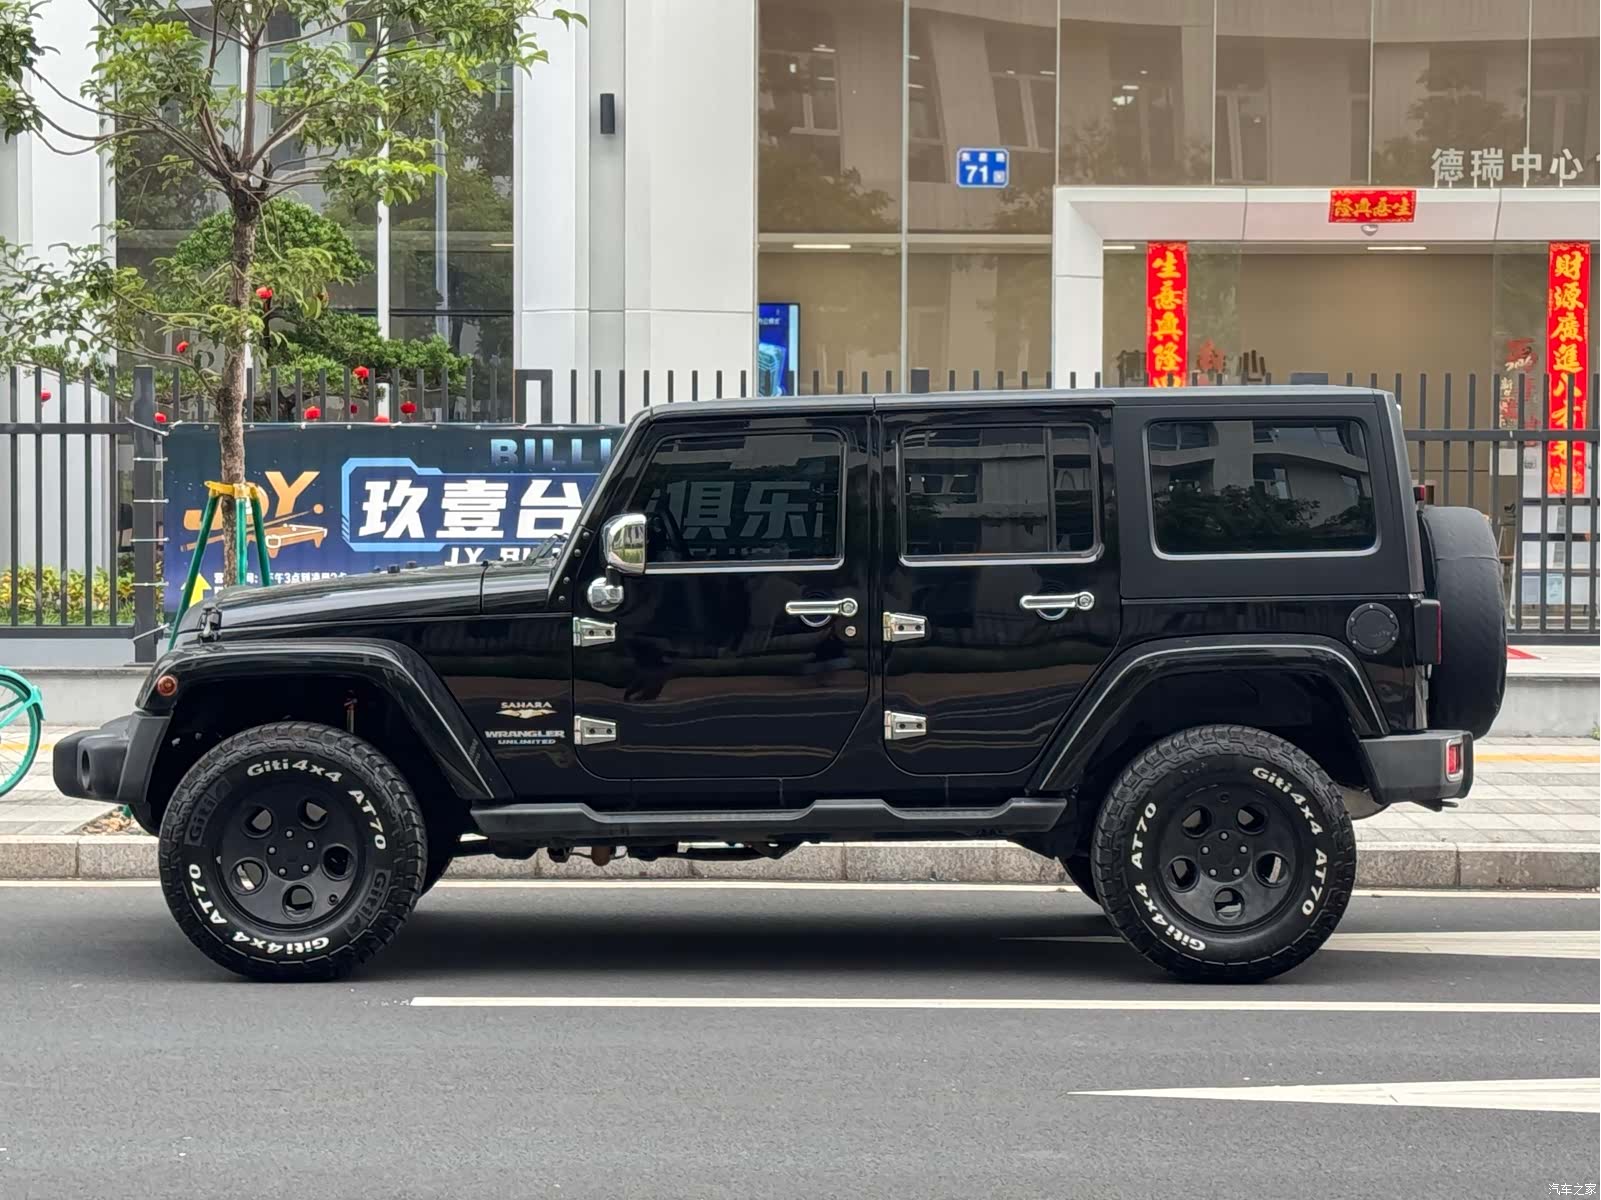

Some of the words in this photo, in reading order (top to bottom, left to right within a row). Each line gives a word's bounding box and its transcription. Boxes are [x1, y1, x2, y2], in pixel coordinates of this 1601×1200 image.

[965, 165, 988, 183] 71
[1431, 147, 1600, 181] 德瑞中心
[359, 480, 583, 538] 玖壹台
[484, 730, 565, 738] WRANGLER
[347, 789, 387, 851] AT70
[1131, 802, 1157, 870] AT70
[188, 864, 228, 925] AT70
[1301, 848, 1328, 916] AT70
